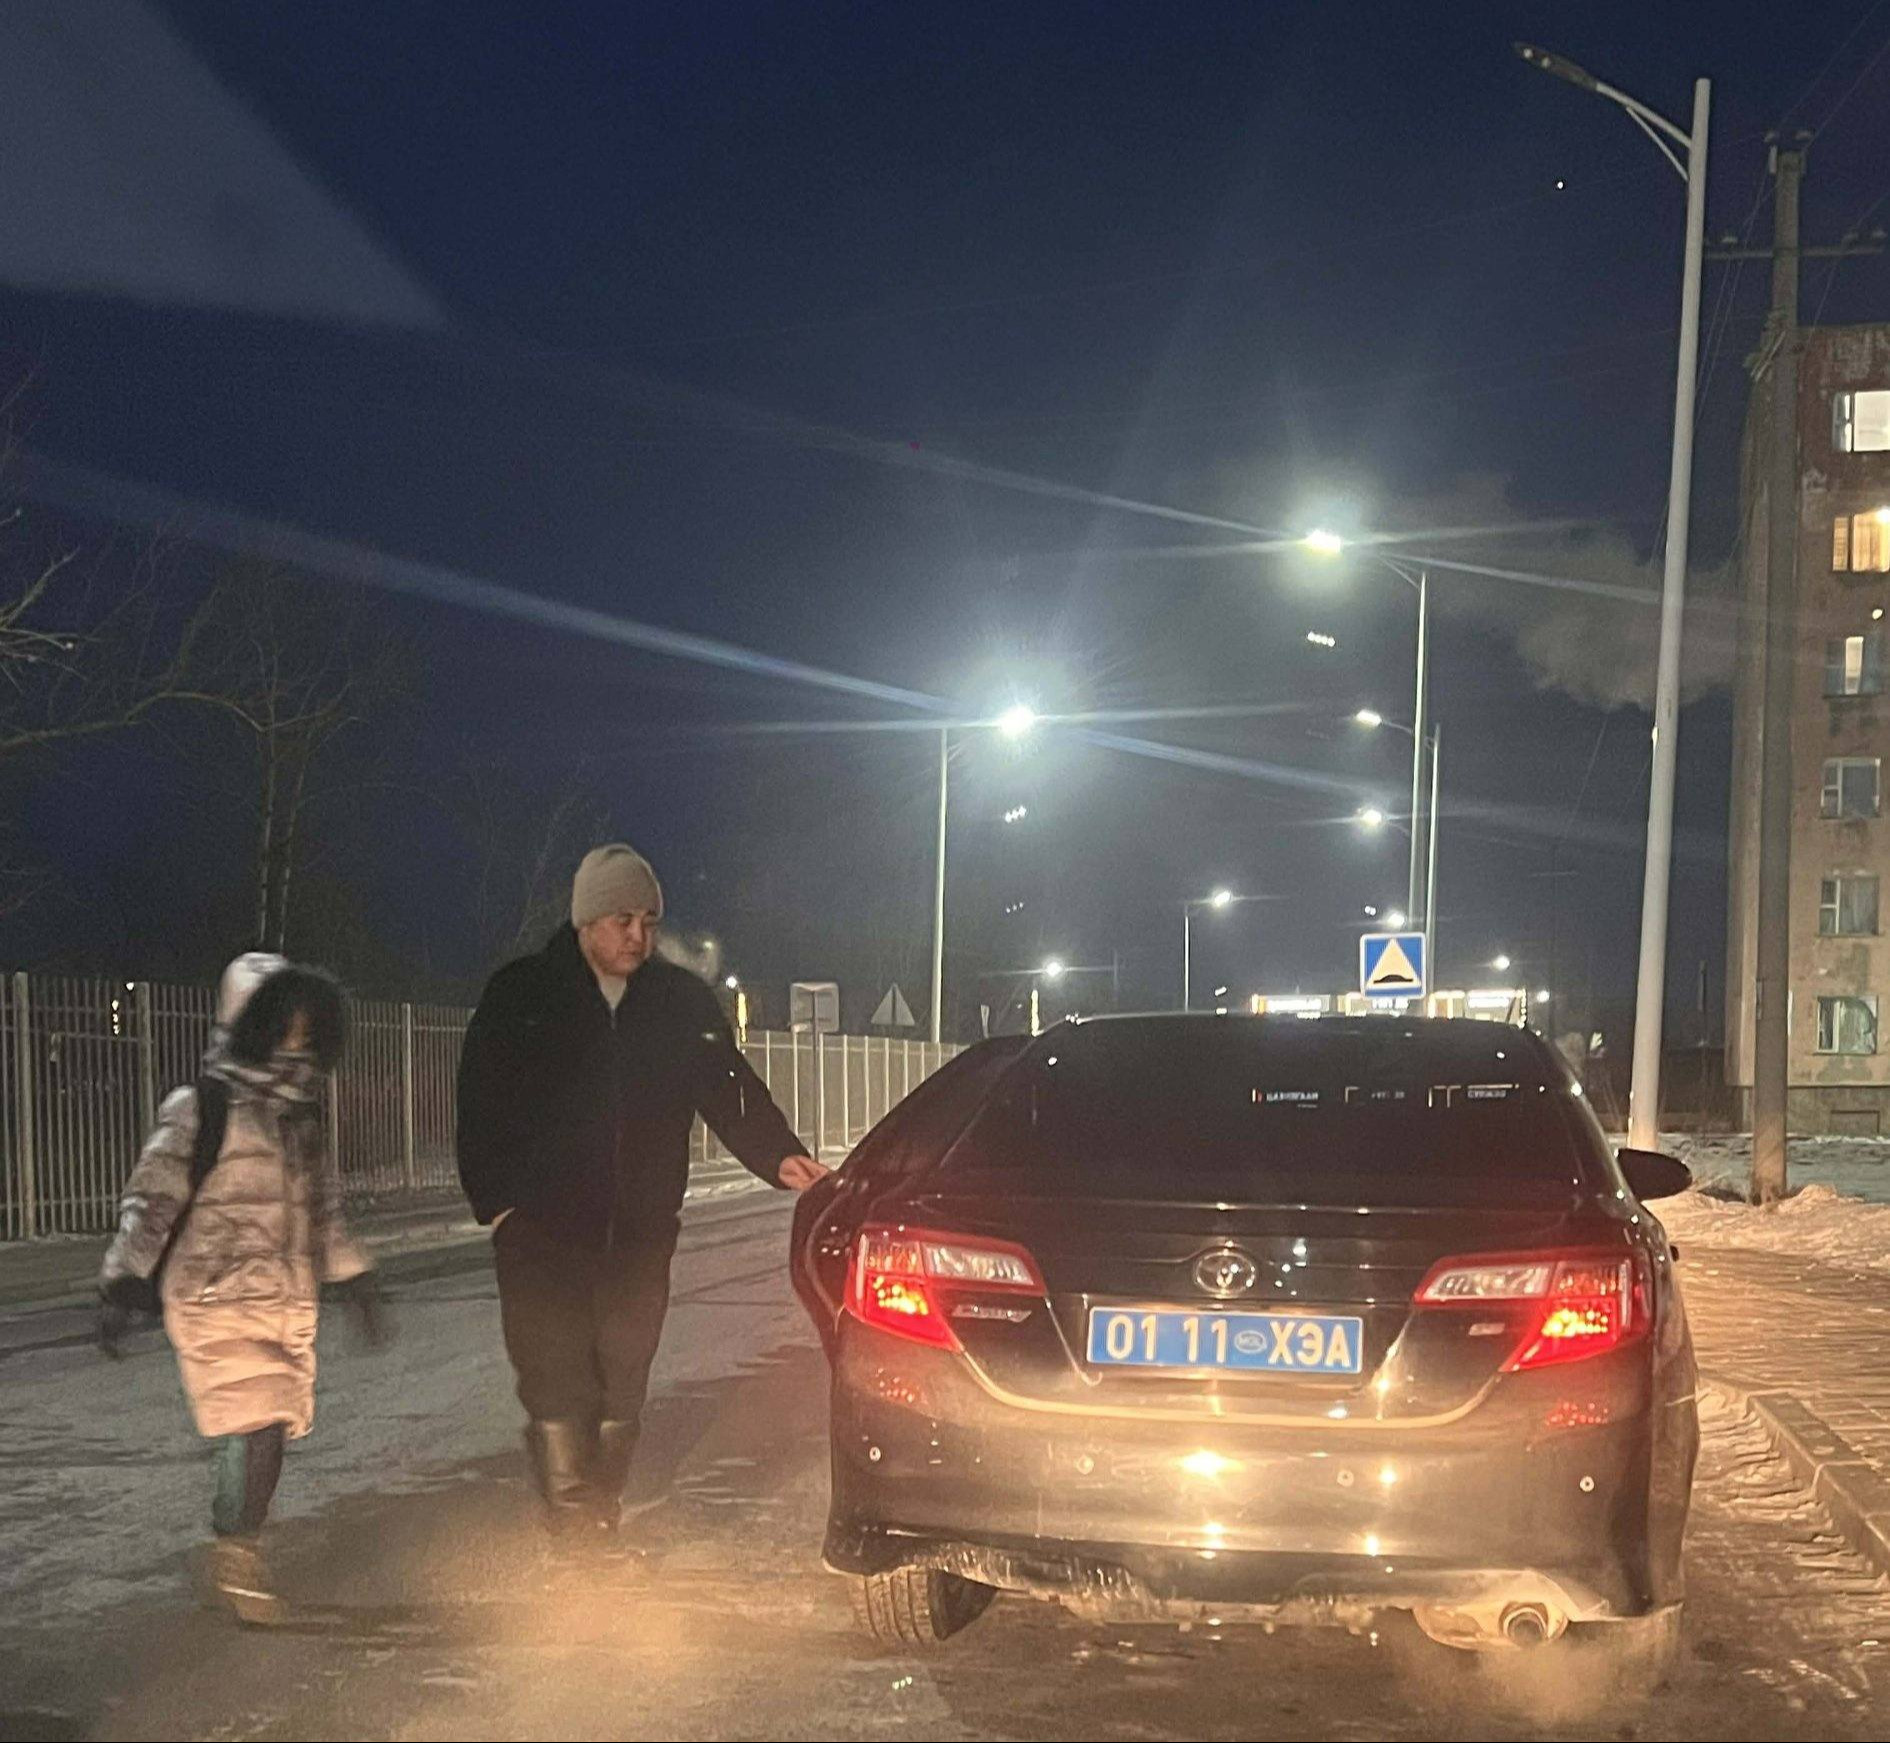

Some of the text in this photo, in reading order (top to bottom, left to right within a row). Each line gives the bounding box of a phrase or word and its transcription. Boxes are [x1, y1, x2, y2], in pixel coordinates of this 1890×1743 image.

[1107, 1314, 1157, 1360] 01
[1183, 1316, 1228, 1363] 11
[1268, 1320, 1351, 1367] ХЭА
